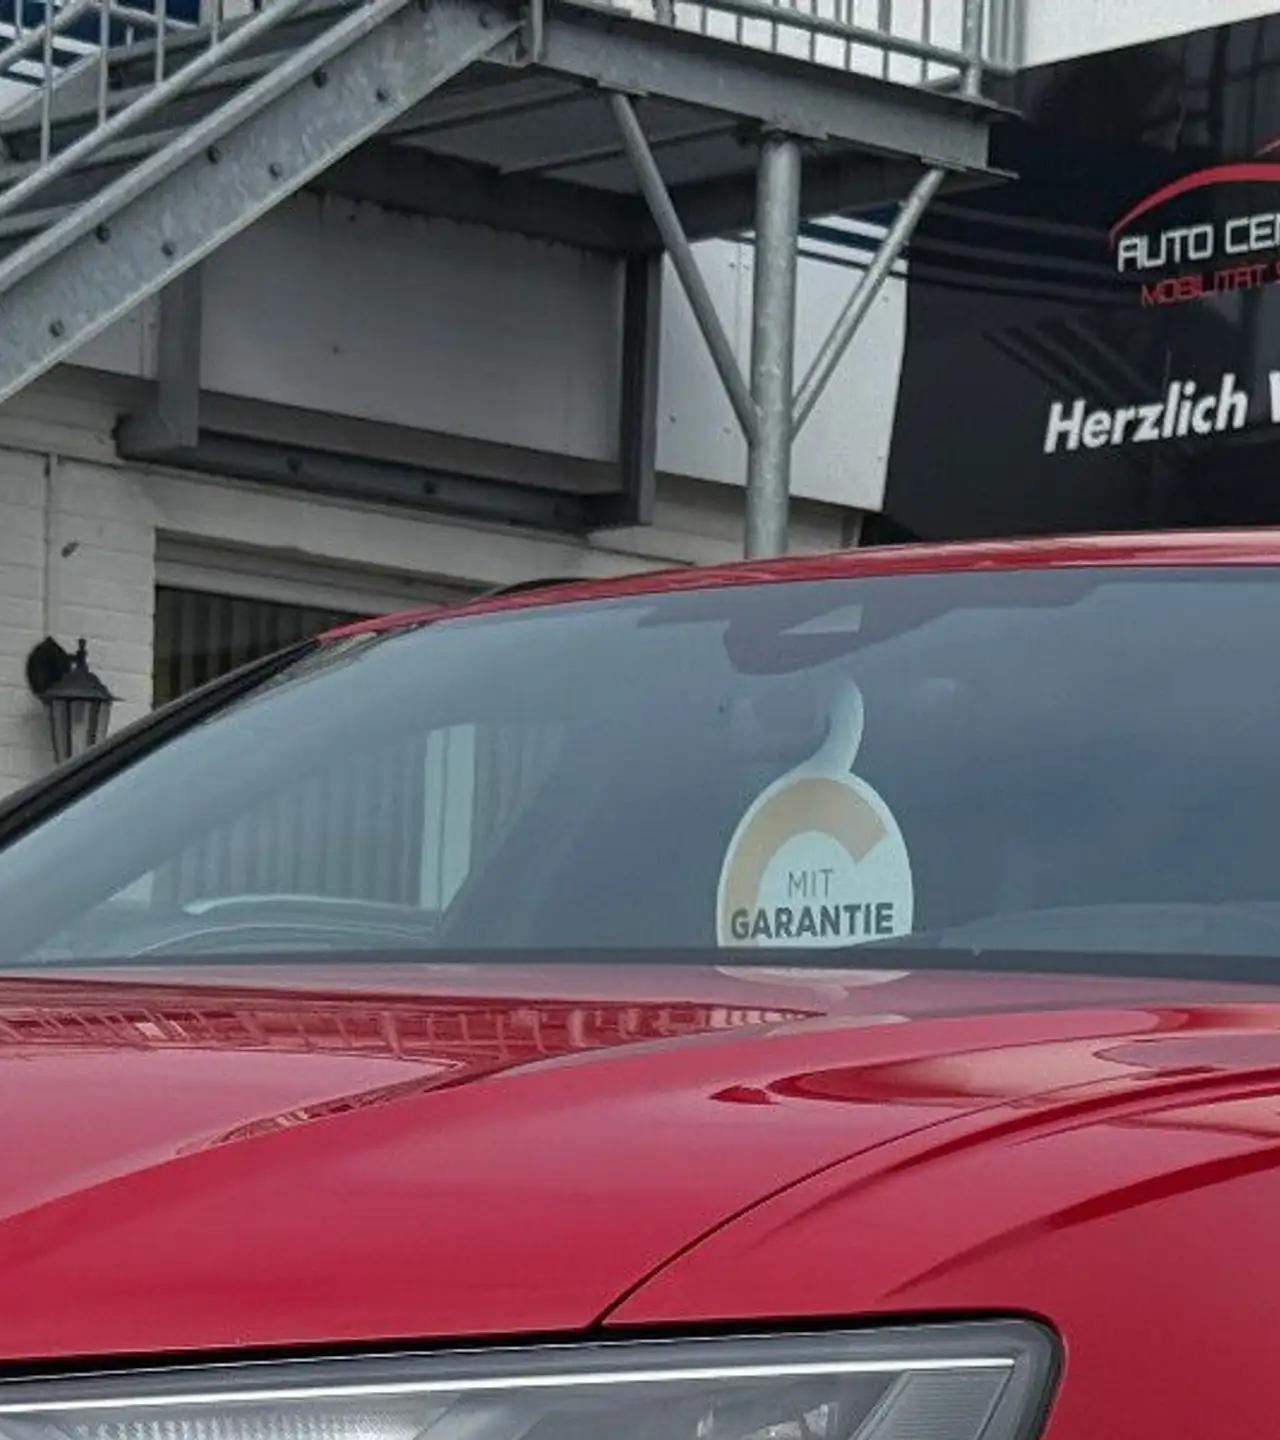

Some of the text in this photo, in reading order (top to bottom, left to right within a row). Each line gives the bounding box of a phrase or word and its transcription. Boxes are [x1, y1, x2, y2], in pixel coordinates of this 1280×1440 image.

[1118, 224, 1213, 272] AUTO
[1043, 374, 1248, 453] Herzlich
[787, 868, 834, 898] MIT
[730, 901, 895, 940] GARANTIE
